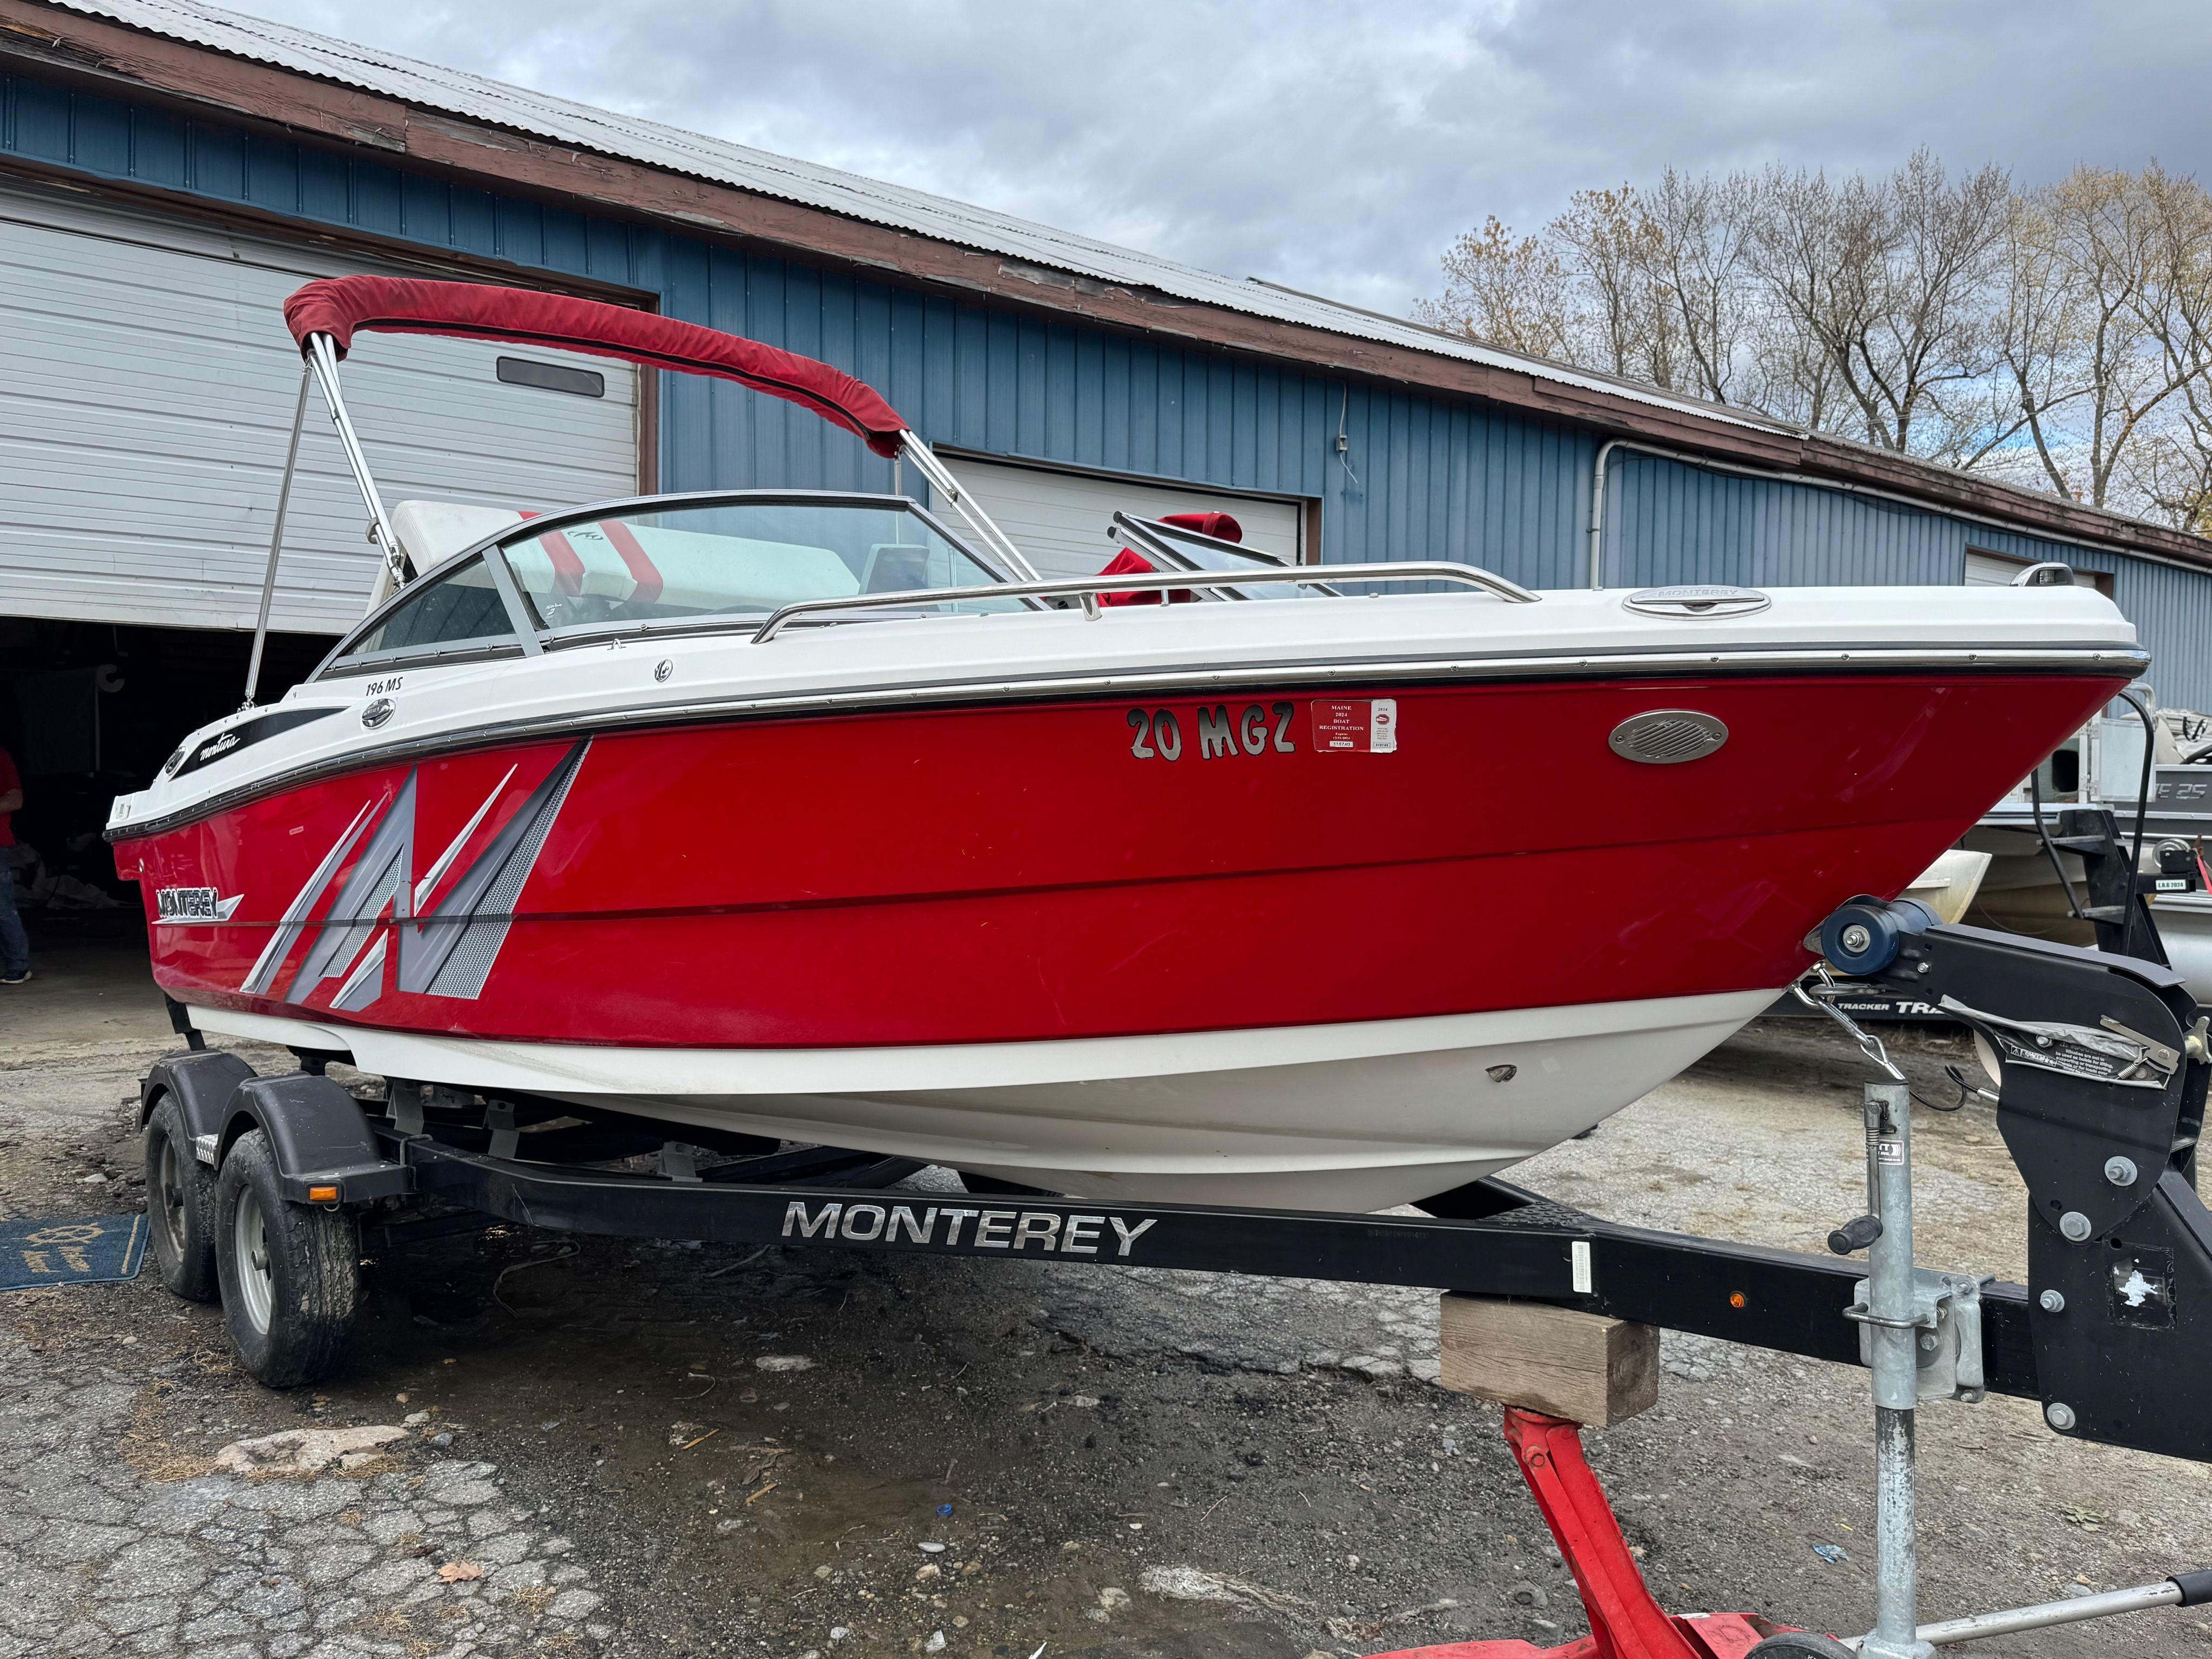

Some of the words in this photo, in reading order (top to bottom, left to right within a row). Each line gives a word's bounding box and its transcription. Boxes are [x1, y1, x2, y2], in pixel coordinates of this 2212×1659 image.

[366, 680, 383, 696] 196
[385, 677, 403, 692] MS
[200, 732, 241, 761] montura
[1127, 707, 1182, 762] 20
[2176, 783, 2208, 800] 25
[156, 887, 218, 918] MONTEREY
[781, 1201, 1158, 1257] MONTEREY
